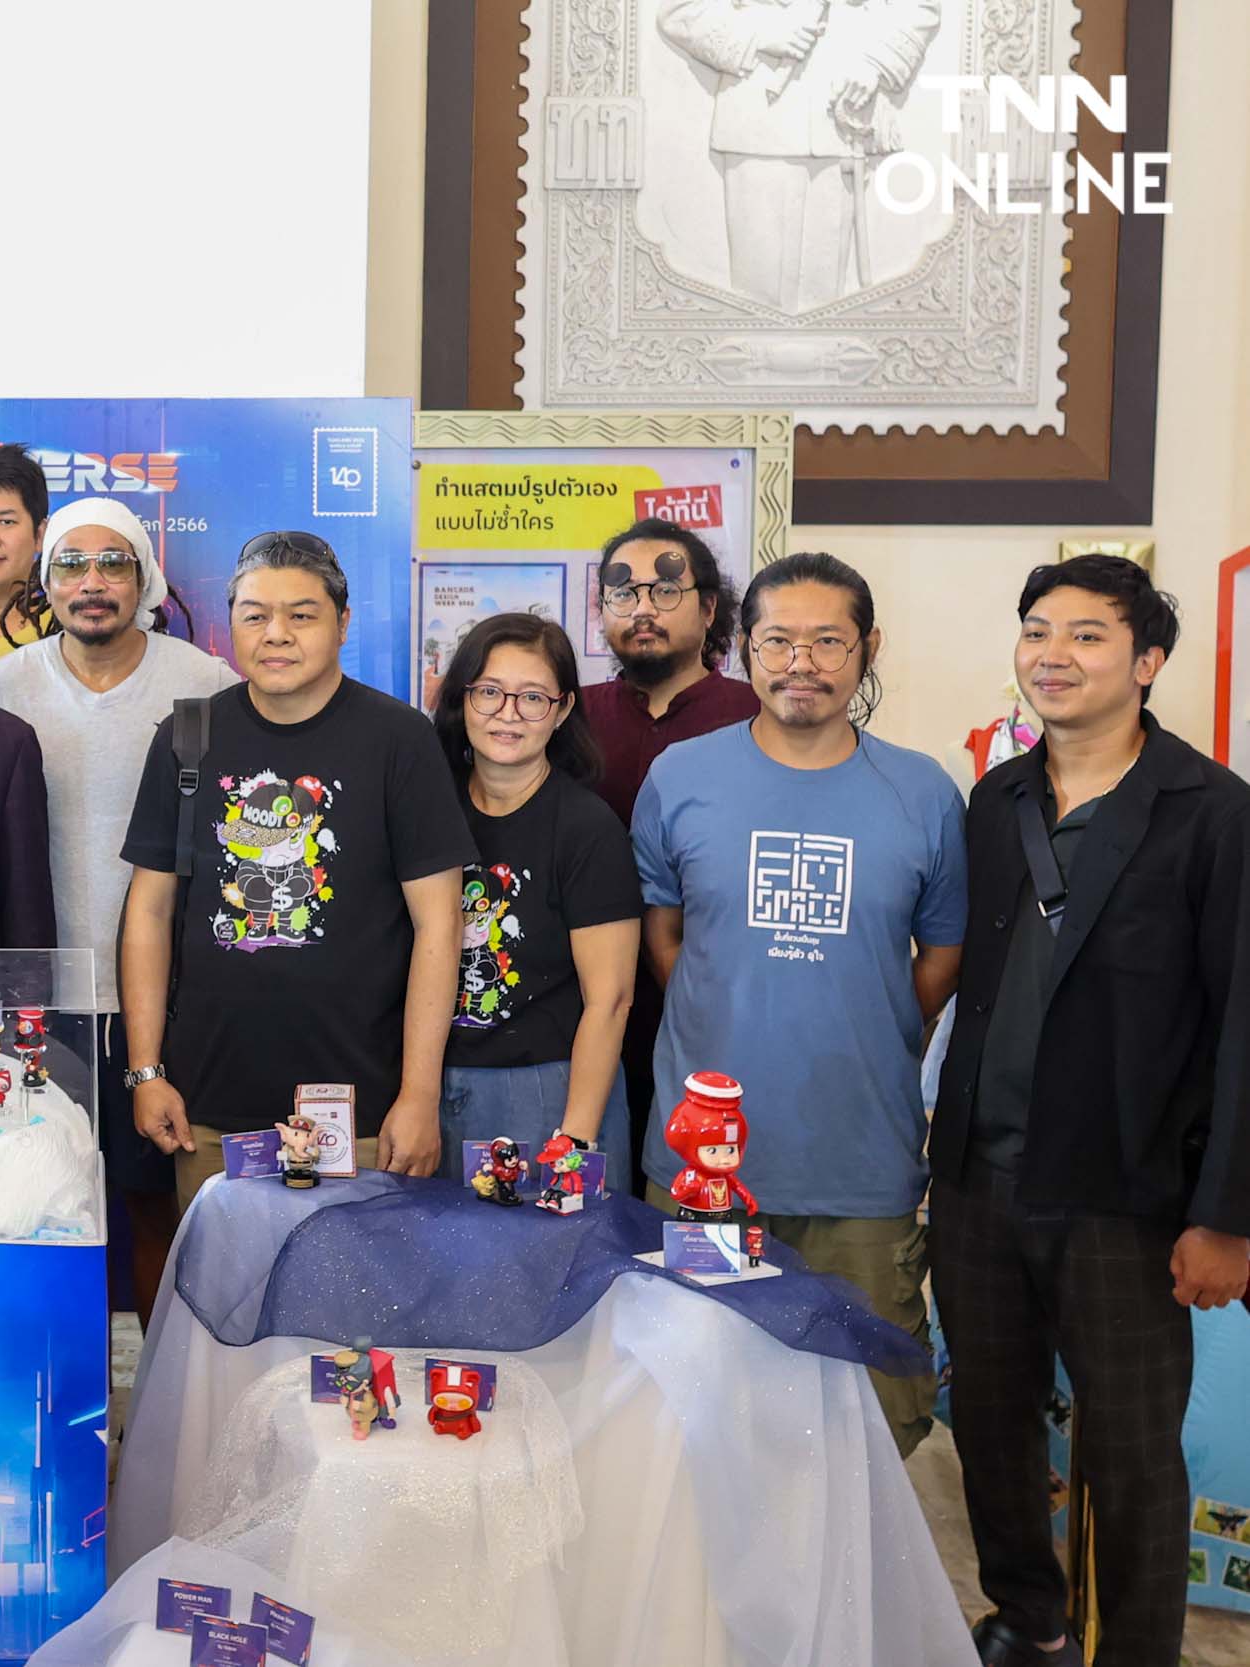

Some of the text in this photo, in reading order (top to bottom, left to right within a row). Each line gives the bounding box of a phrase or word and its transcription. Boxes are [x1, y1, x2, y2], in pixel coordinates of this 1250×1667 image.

[435, 475, 618, 504] ทำแสตมป์รูปตัวเอง
[166, 517, 208, 533] 2566
[435, 504, 554, 531] แบบไม่ซ้ำใคร
[756, 888, 842, 926] SPACE
